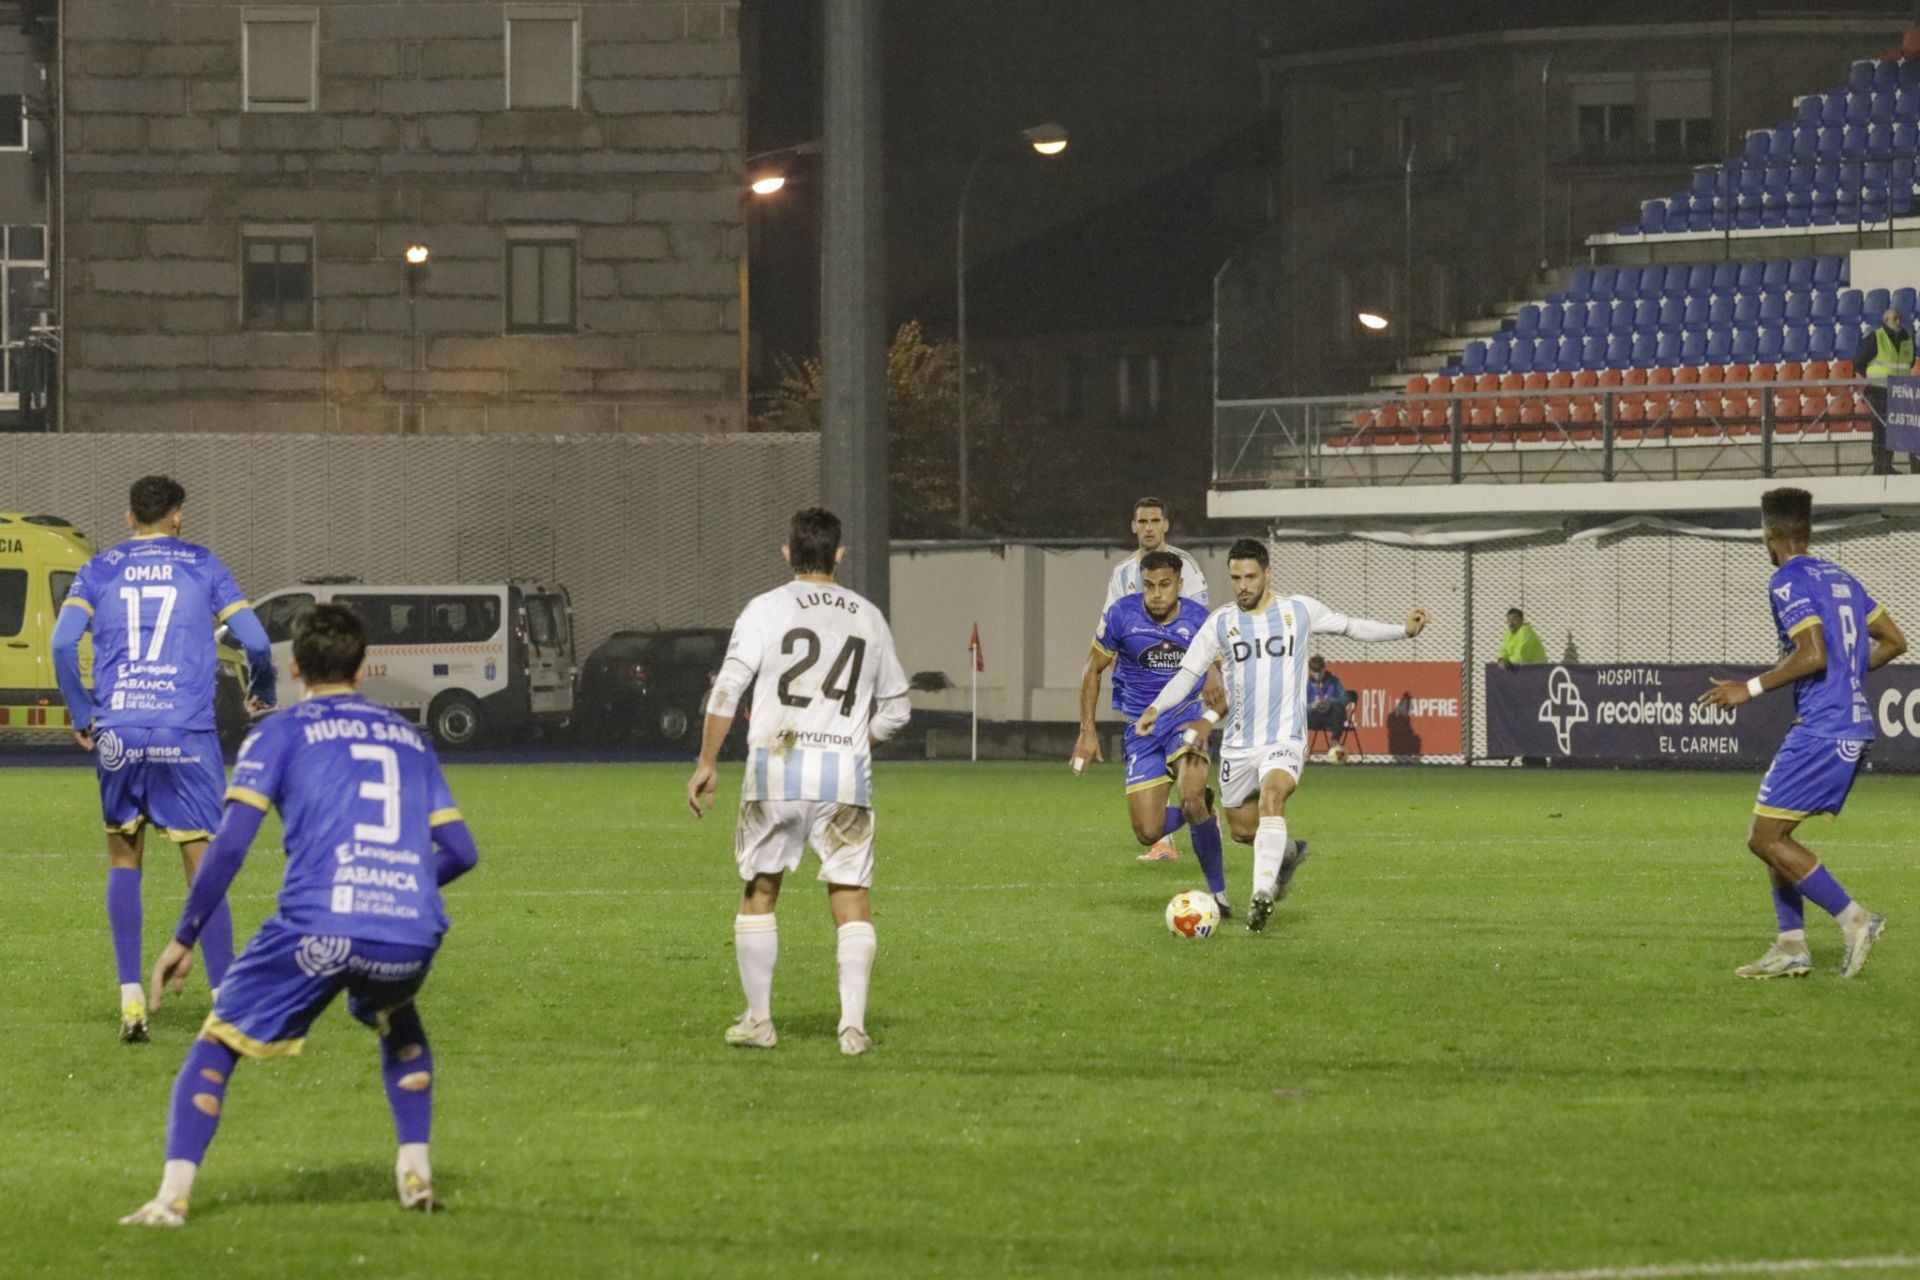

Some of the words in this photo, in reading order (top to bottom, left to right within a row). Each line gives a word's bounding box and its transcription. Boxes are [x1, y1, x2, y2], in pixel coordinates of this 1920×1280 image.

[124, 565, 173, 581] OMAR
[796, 592, 860, 614] LUCAS
[120, 586, 177, 661] 17
[1232, 635, 1294, 663] DIGI
[367, 664, 388, 677] 112
[778, 627, 866, 718] 24
[1597, 669, 1662, 686] HOSPITAL
[116, 679, 176, 691] ABANCA
[1362, 689, 1386, 728] REY
[1597, 692, 1683, 725] recoletas
[304, 718, 368, 745] HUGO
[1659, 736, 1676, 753] EL
[1680, 737, 1739, 754] CARMEN
[1221, 760, 1231, 782] 8
[350, 744, 400, 844] 3
[336, 866, 419, 892] ABANCA
